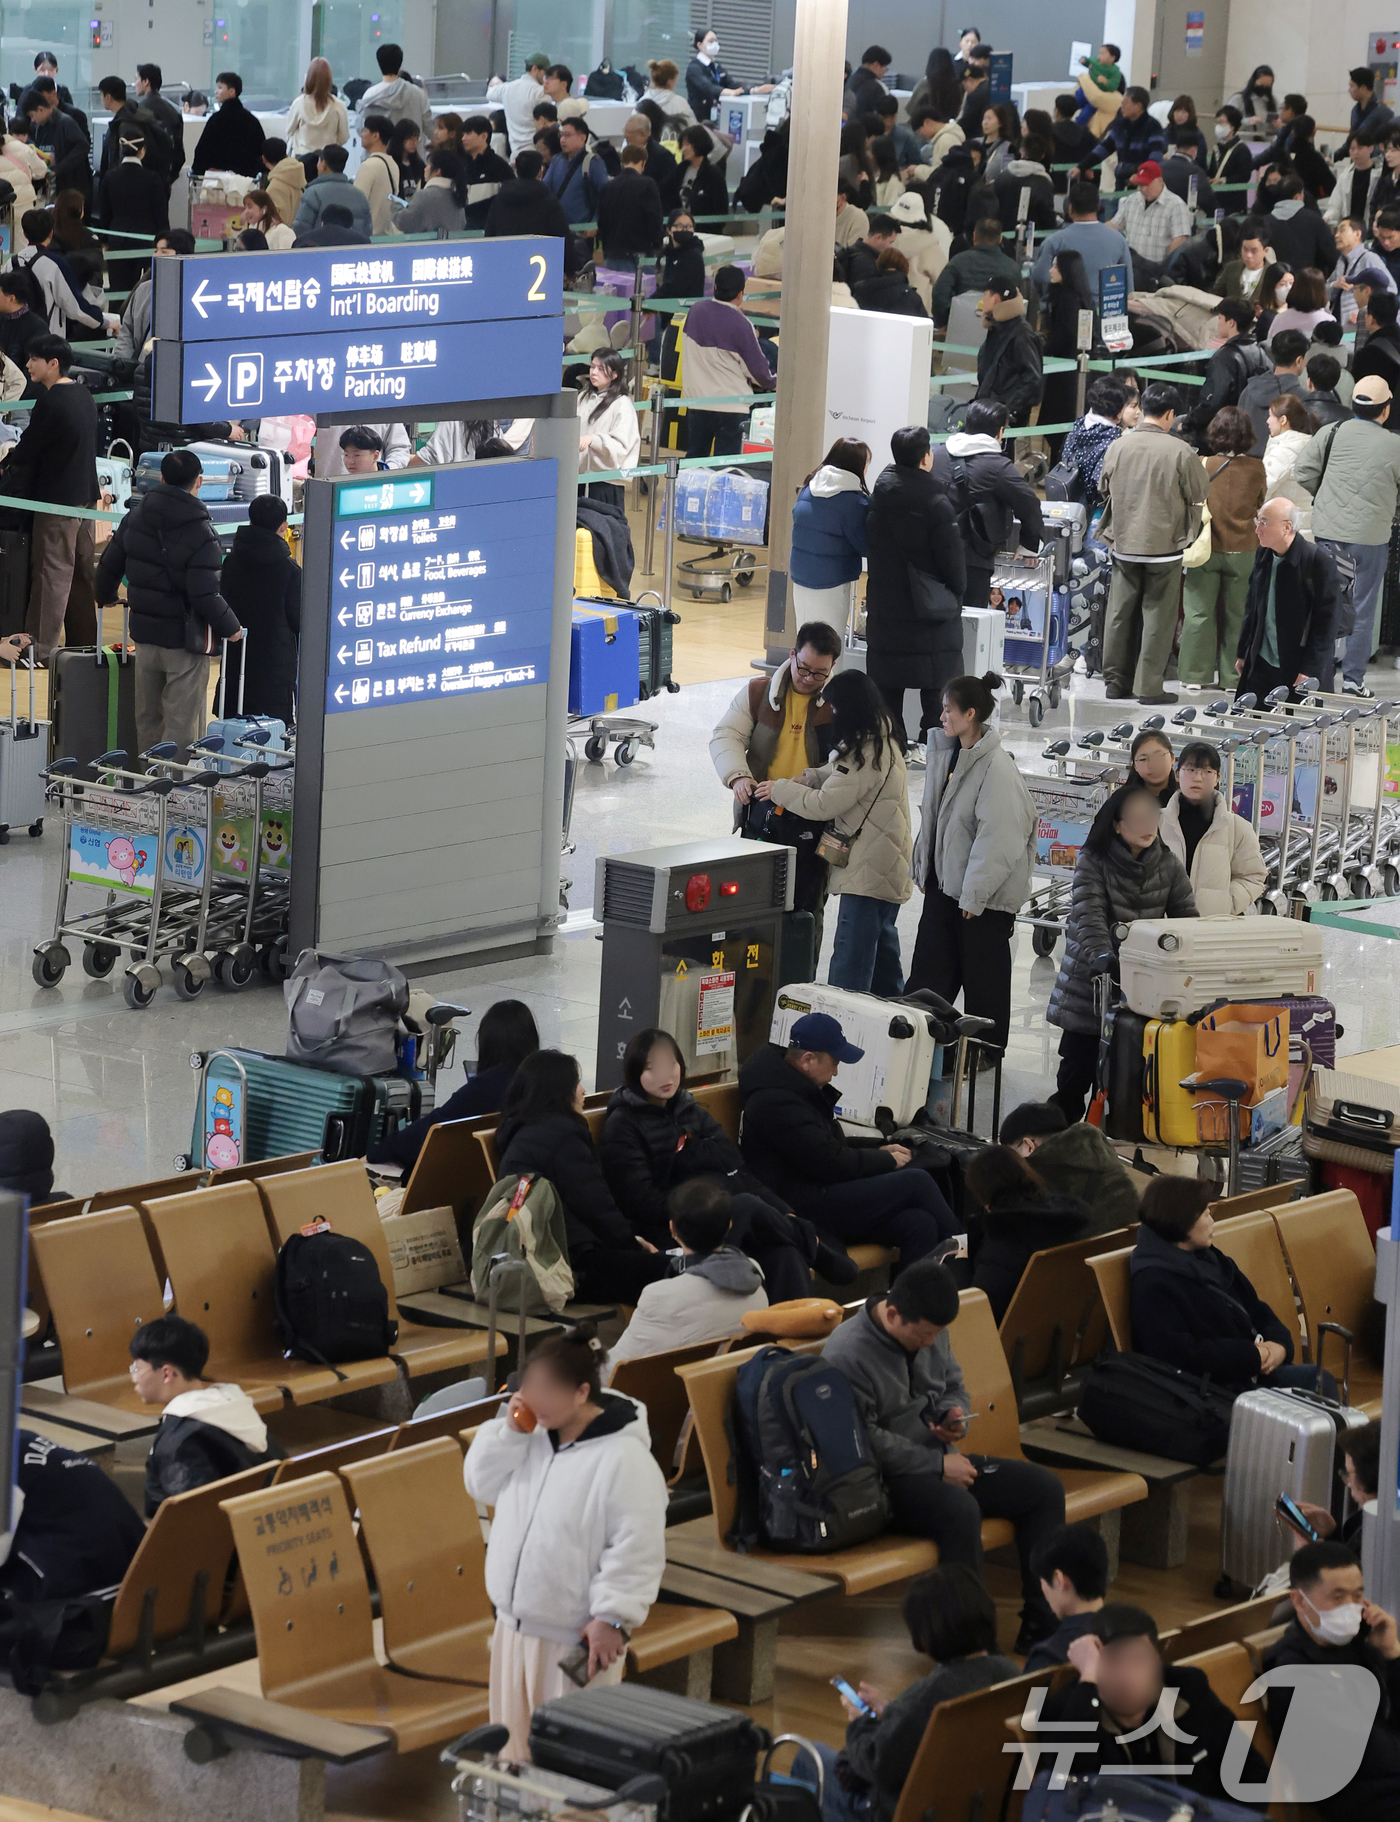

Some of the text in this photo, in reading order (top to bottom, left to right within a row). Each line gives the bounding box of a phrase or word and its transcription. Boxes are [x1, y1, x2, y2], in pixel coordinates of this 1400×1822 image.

[527, 255, 546, 301] 2
[227, 277, 321, 314] 국제선탑승
[330, 288, 440, 317] Int'l Boarding
[346, 339, 437, 369] 停车场 駐車場
[273, 357, 336, 394] 주차장
[344, 372, 406, 400] Parking
[379, 524, 409, 544] 화장실
[411, 531, 438, 545] Toilets
[401, 561, 421, 580] 음료
[424, 561, 487, 582] Food, Beverages
[399, 603, 473, 621] Currency Exchange
[376, 641, 397, 658] Tax
[399, 632, 441, 655] Refund
[504, 667, 535, 683] Check-in
[88, 838, 100, 848] 신협
[253, 1494, 333, 1537] 교통약자배려석
[266, 1526, 333, 1556] PRIORITY SEATS
